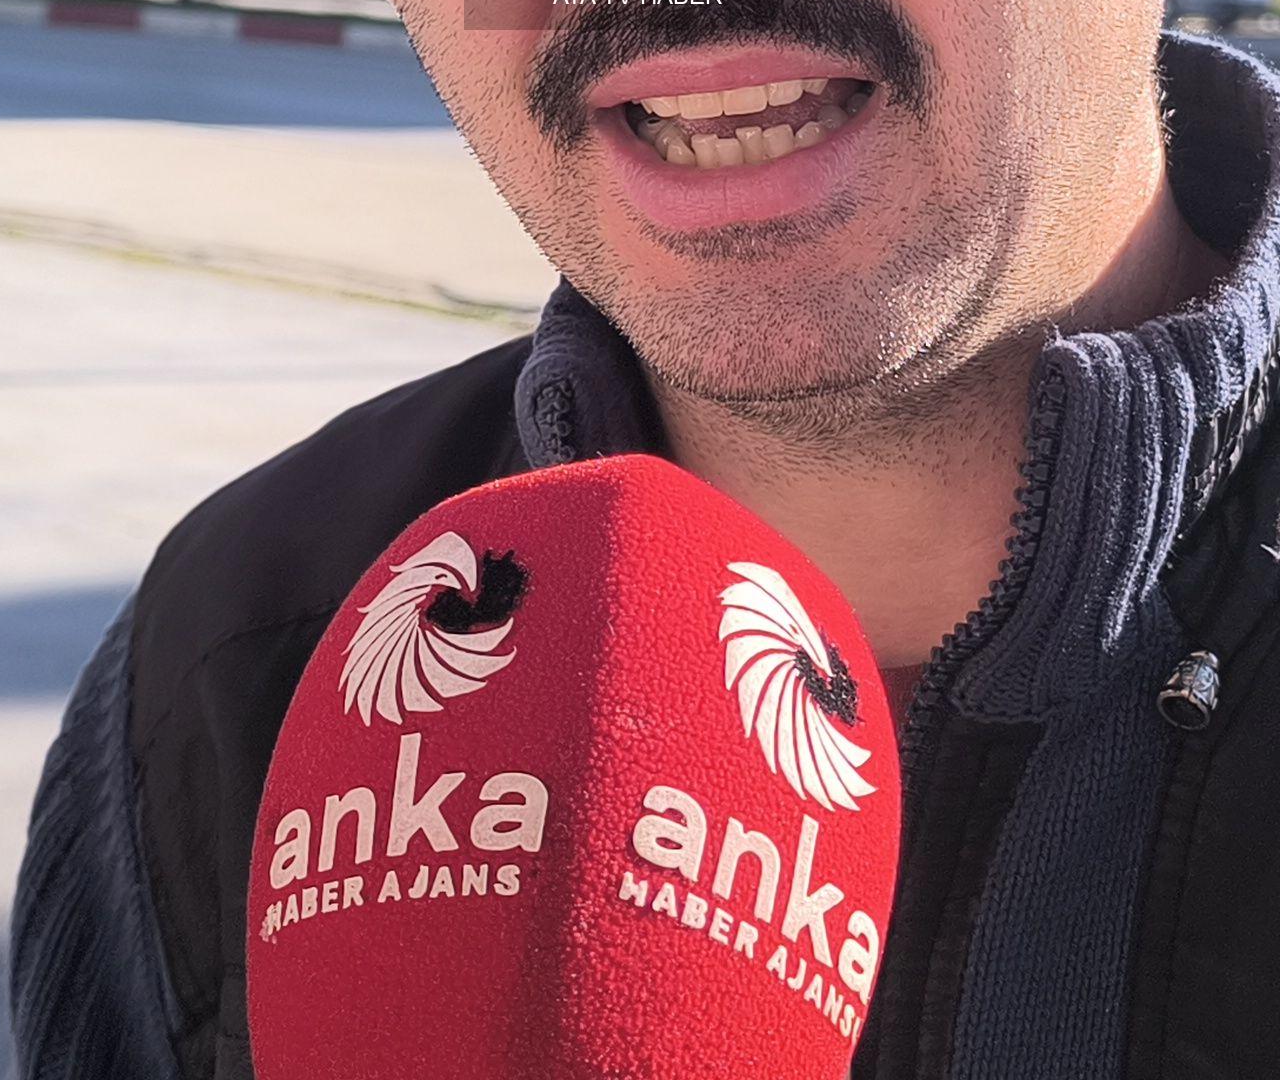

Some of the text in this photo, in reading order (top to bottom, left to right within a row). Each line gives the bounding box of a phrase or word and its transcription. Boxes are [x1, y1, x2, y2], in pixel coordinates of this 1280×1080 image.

[268, 733, 549, 890] anka
[262, 876, 364, 936] HABER
[619, 872, 759, 960] HABER
[632, 785, 880, 1006] anka
